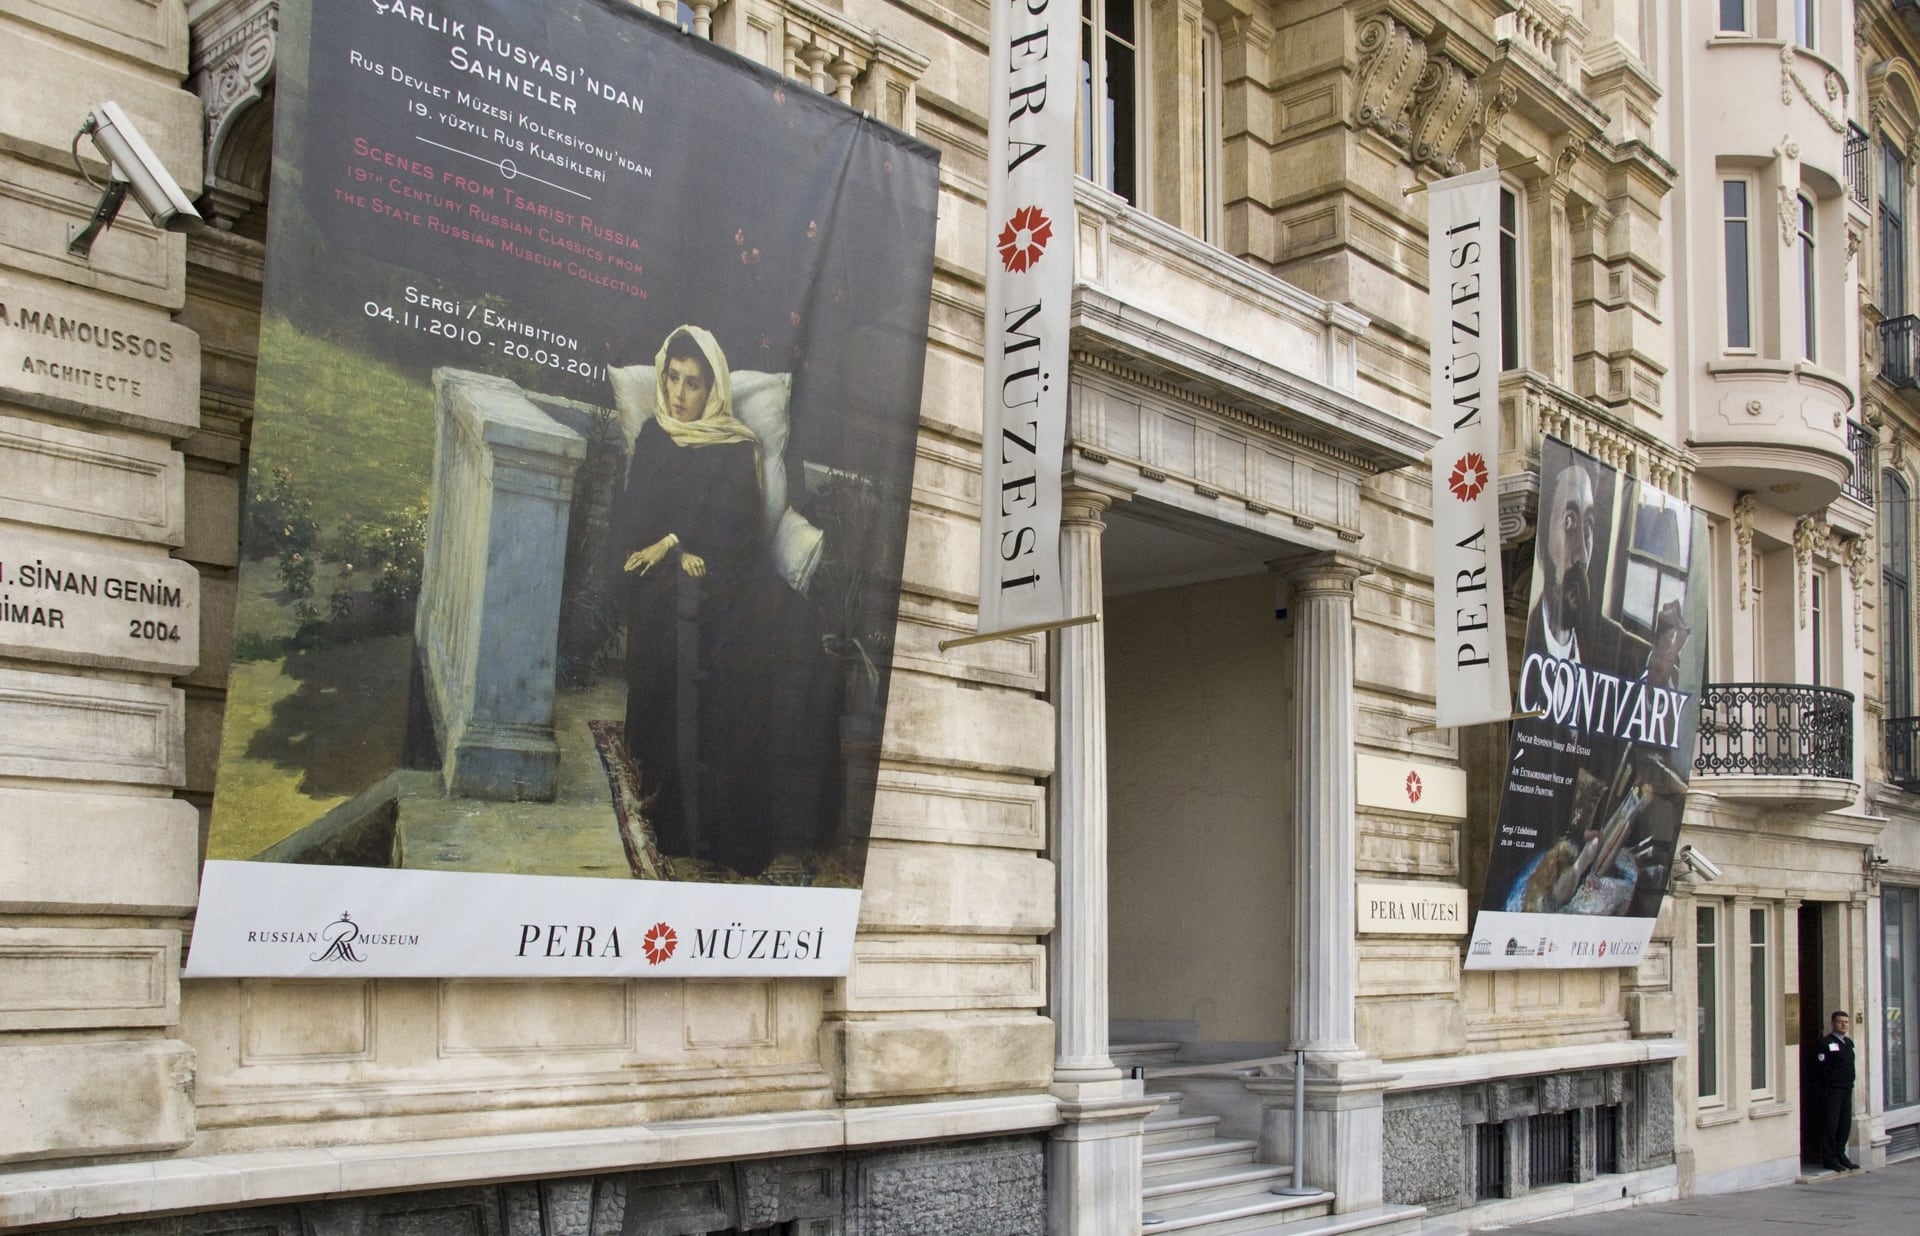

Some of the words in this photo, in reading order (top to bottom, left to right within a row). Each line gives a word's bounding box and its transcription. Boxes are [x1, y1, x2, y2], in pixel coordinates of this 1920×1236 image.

[350, 50, 385, 76] RUS
[391, 67, 452, 100] DEVLET
[449, 46, 578, 115] SAHNELER
[408, 100, 432, 119] 19.
[493, 129, 524, 152] RUS
[354, 137, 435, 180] SCENES
[442, 172, 495, 200] FROM
[503, 187, 576, 228] TSARIST
[580, 215, 641, 251] RUSSIA
[334, 189, 365, 208] THE
[371, 198, 421, 227] STATE
[428, 215, 495, 248] RUSSIAN
[501, 239, 562, 271] MUSEUM
[389, 179, 463, 213] CENTURY
[469, 203, 533, 237] RUSSIAN
[538, 227, 603, 262] CLASSICS
[363, 301, 482, 346] 04.11.2010
[503, 339, 607, 382] 20.03.2011
[483, 308, 579, 351] EXHIBITION
[1444, 215, 1483, 434] MÜZESİ
[22, 356, 142, 397] ARCHITECTE
[1000, 298, 1050, 596] MÜZESİ
[104, 577, 181, 608] GENİM
[1455, 523, 1491, 672] PERA
[0, 594, 64, 629] İMAR
[129, 619, 181, 643] 2004
[1370, 900, 1406, 920] PERA
[1410, 899, 1459, 922] MÜZESİ
[247, 930, 318, 945] RUSSIAN
[358, 933, 419, 945] MUSEUM
[515, 924, 622, 958] PERA
[690, 923, 825, 960] MÜZESİ
[1571, 941, 1595, 956] PERA
